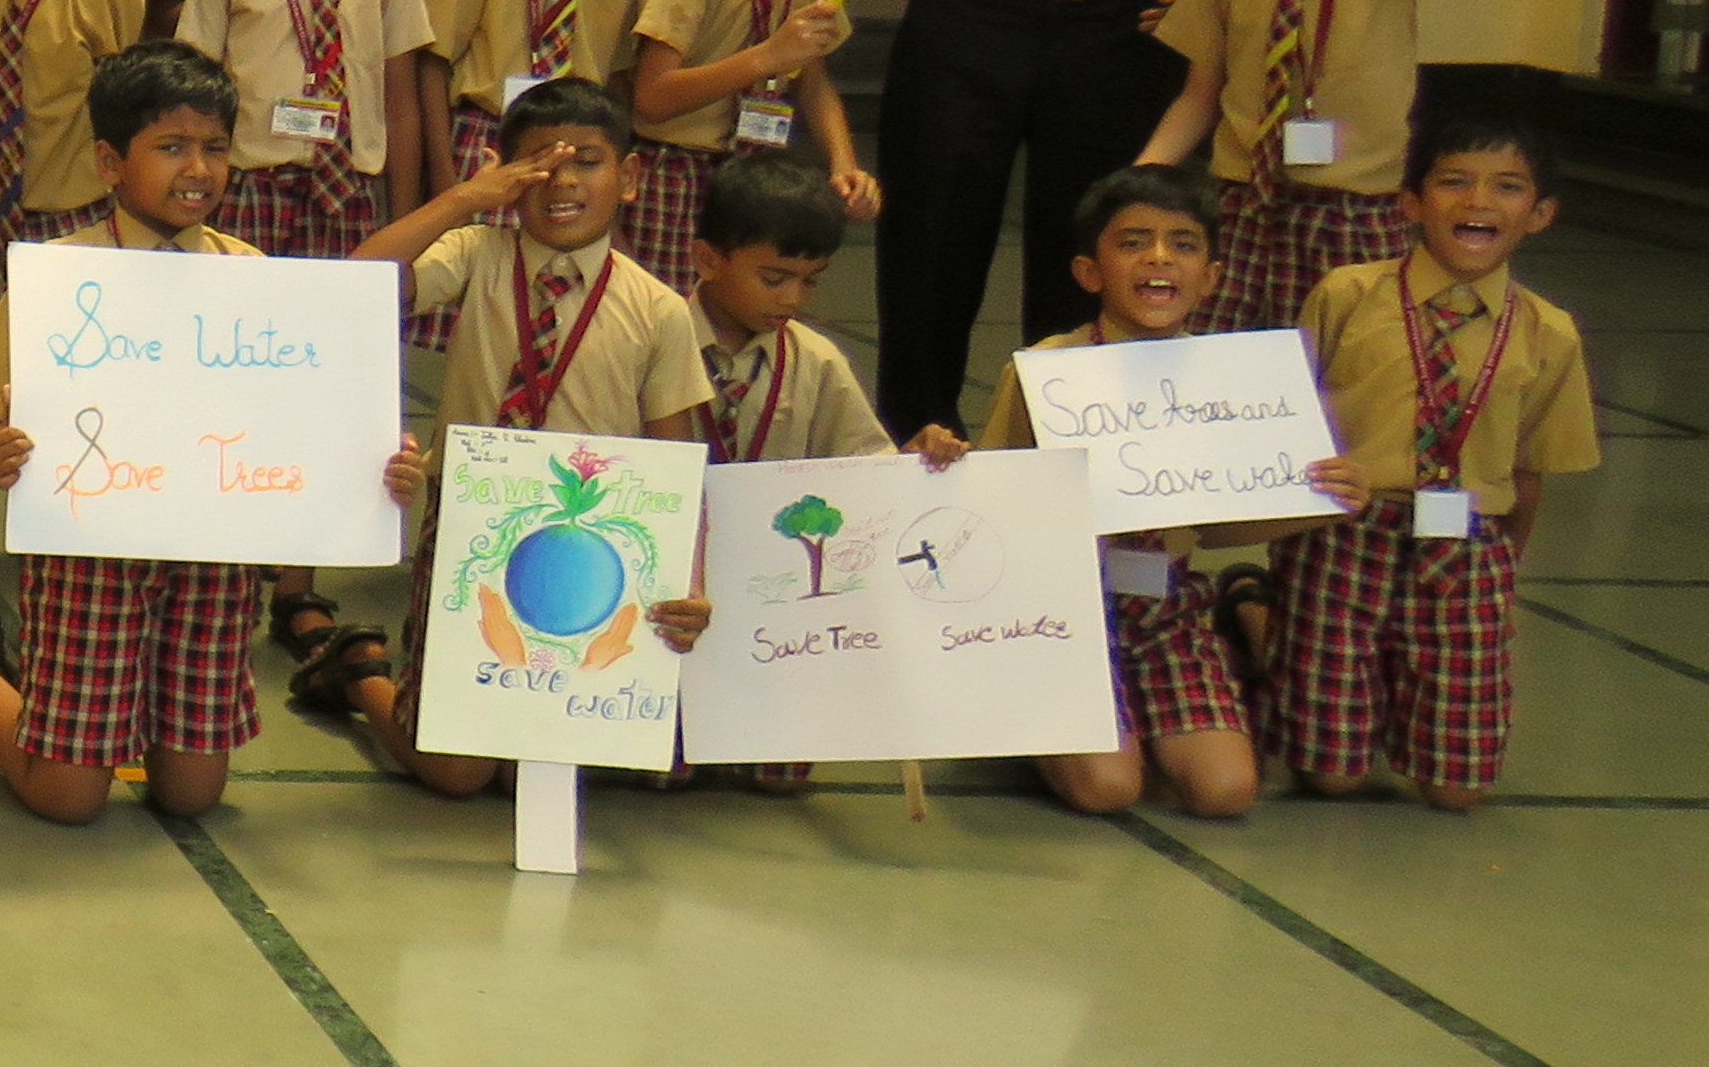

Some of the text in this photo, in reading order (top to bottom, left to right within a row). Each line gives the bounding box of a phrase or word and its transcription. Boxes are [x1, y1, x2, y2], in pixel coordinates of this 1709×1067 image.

[46, 280, 322, 380] Save Water
[1040, 377, 1157, 438] Save
[1236, 395, 1298, 421] and
[53, 405, 307, 521] Save Trees
[452, 462, 546, 505] Save
[1117, 441, 1314, 497] Save wate
[751, 624, 884, 665] Save Tree
[940, 624, 996, 651] Save
